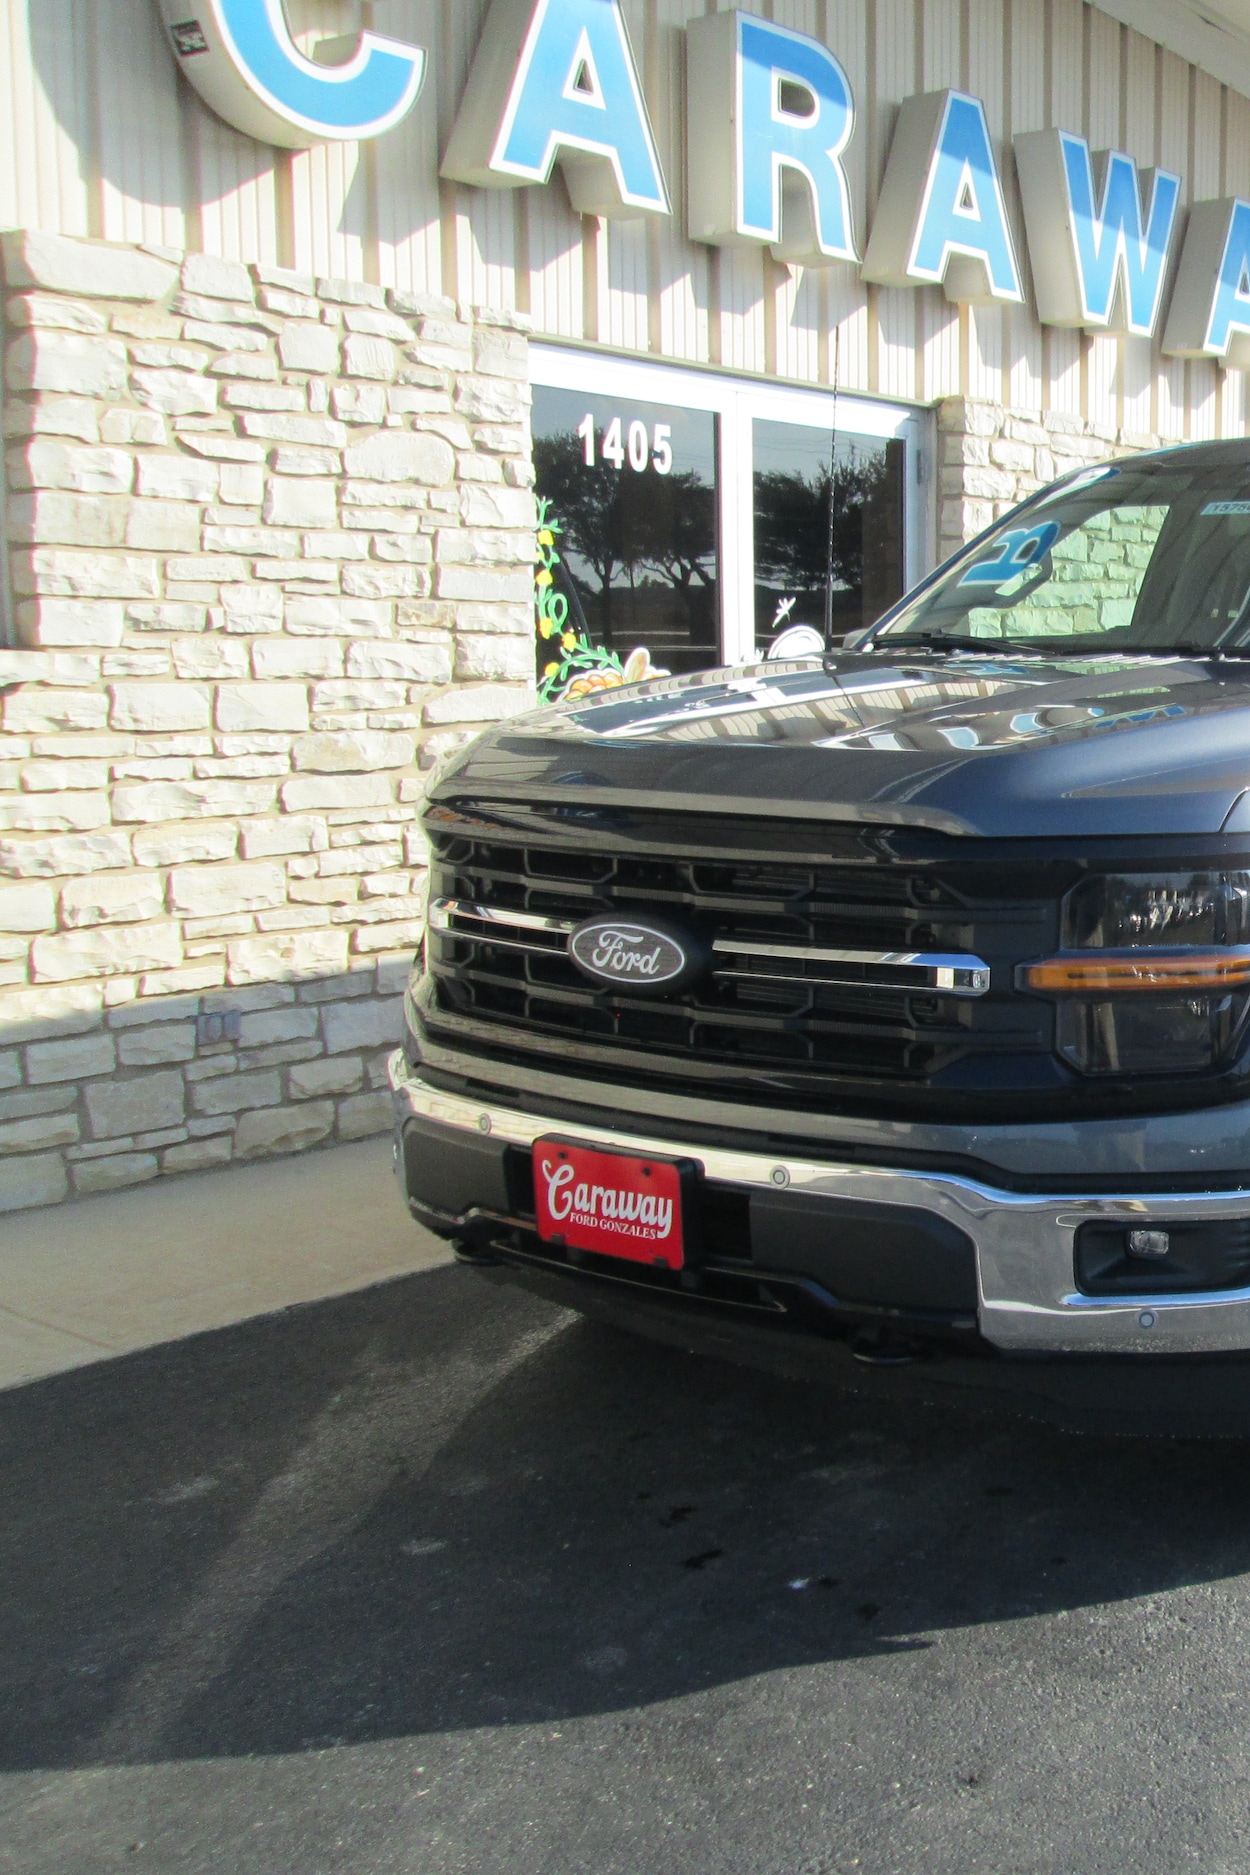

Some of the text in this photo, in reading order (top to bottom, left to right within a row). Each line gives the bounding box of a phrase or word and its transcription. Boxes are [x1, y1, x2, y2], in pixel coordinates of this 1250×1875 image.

[578, 413, 672, 474] 1405
[592, 930, 661, 975] Ford
[542, 1160, 672, 1239] Caraway
[570, 1212, 657, 1239] FORD GONZALES
